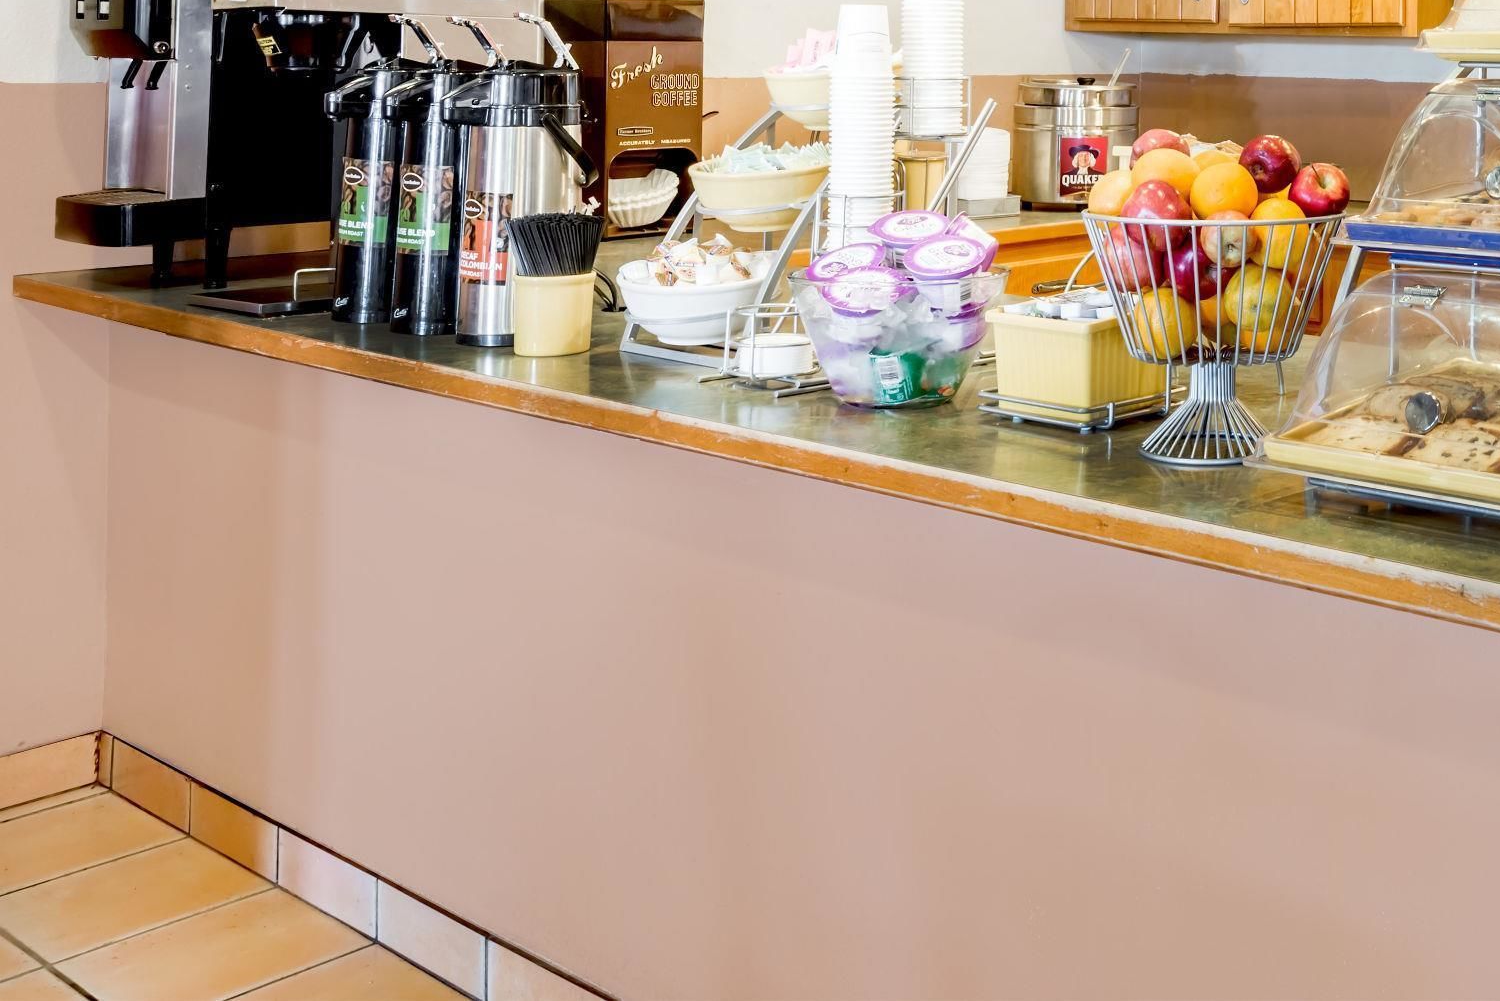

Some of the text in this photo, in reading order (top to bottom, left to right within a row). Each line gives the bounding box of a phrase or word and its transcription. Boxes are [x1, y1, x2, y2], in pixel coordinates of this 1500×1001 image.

[611, 46, 663, 89] Fresh
[650, 74, 700, 90] GROUND
[652, 90, 698, 107] COFFEE
[348, 220, 374, 229] BLEND
[408, 229, 436, 237] BLEND
